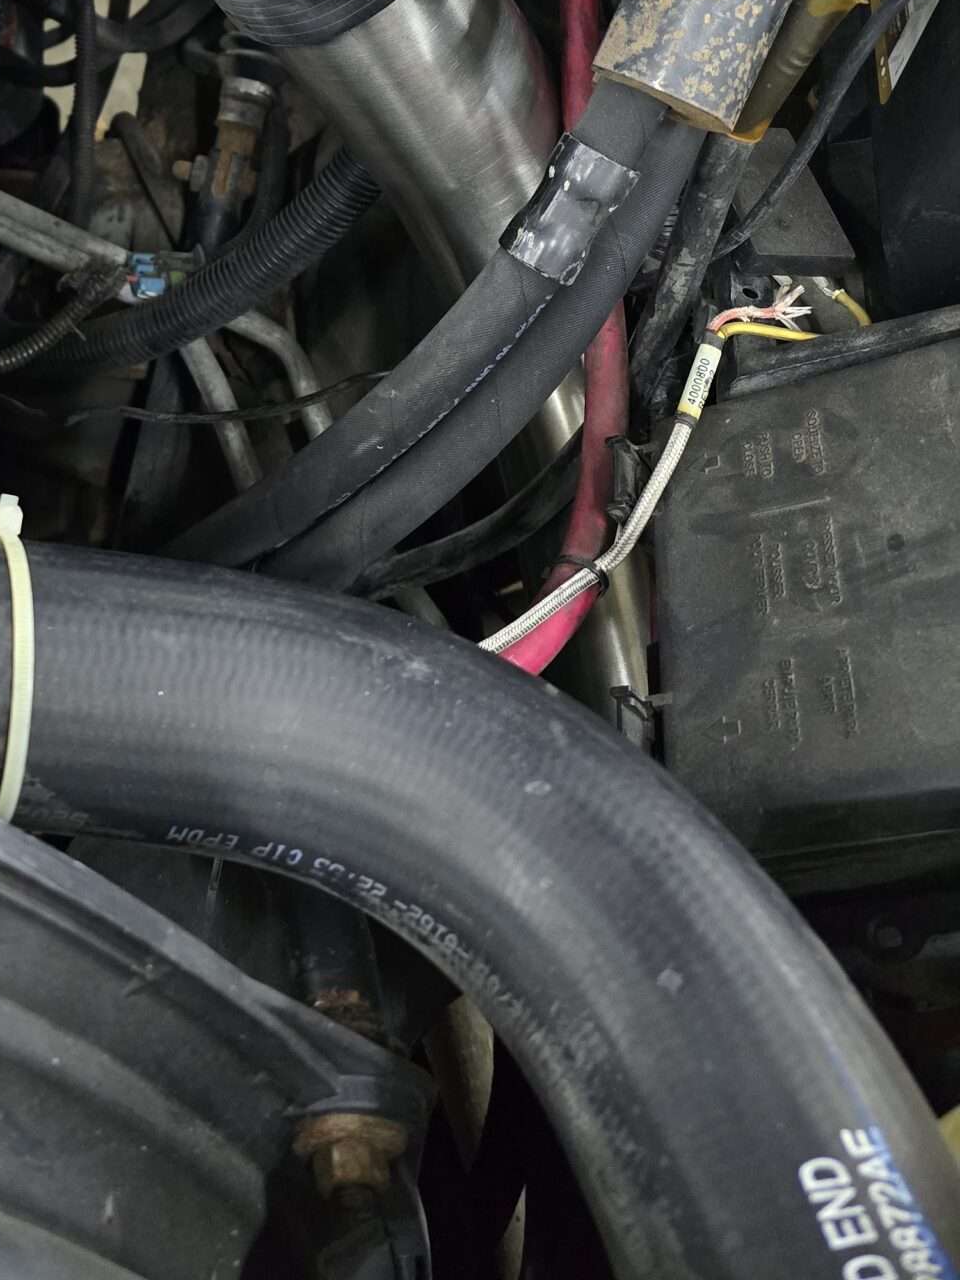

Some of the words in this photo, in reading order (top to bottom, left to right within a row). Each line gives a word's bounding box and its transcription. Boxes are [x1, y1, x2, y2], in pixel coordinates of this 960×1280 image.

[687, 358, 711, 405] 4000800
[166, 825, 240, 850] EPDM
[251, 841, 304, 866] CIP
[797, 1156, 880, 1252] END
